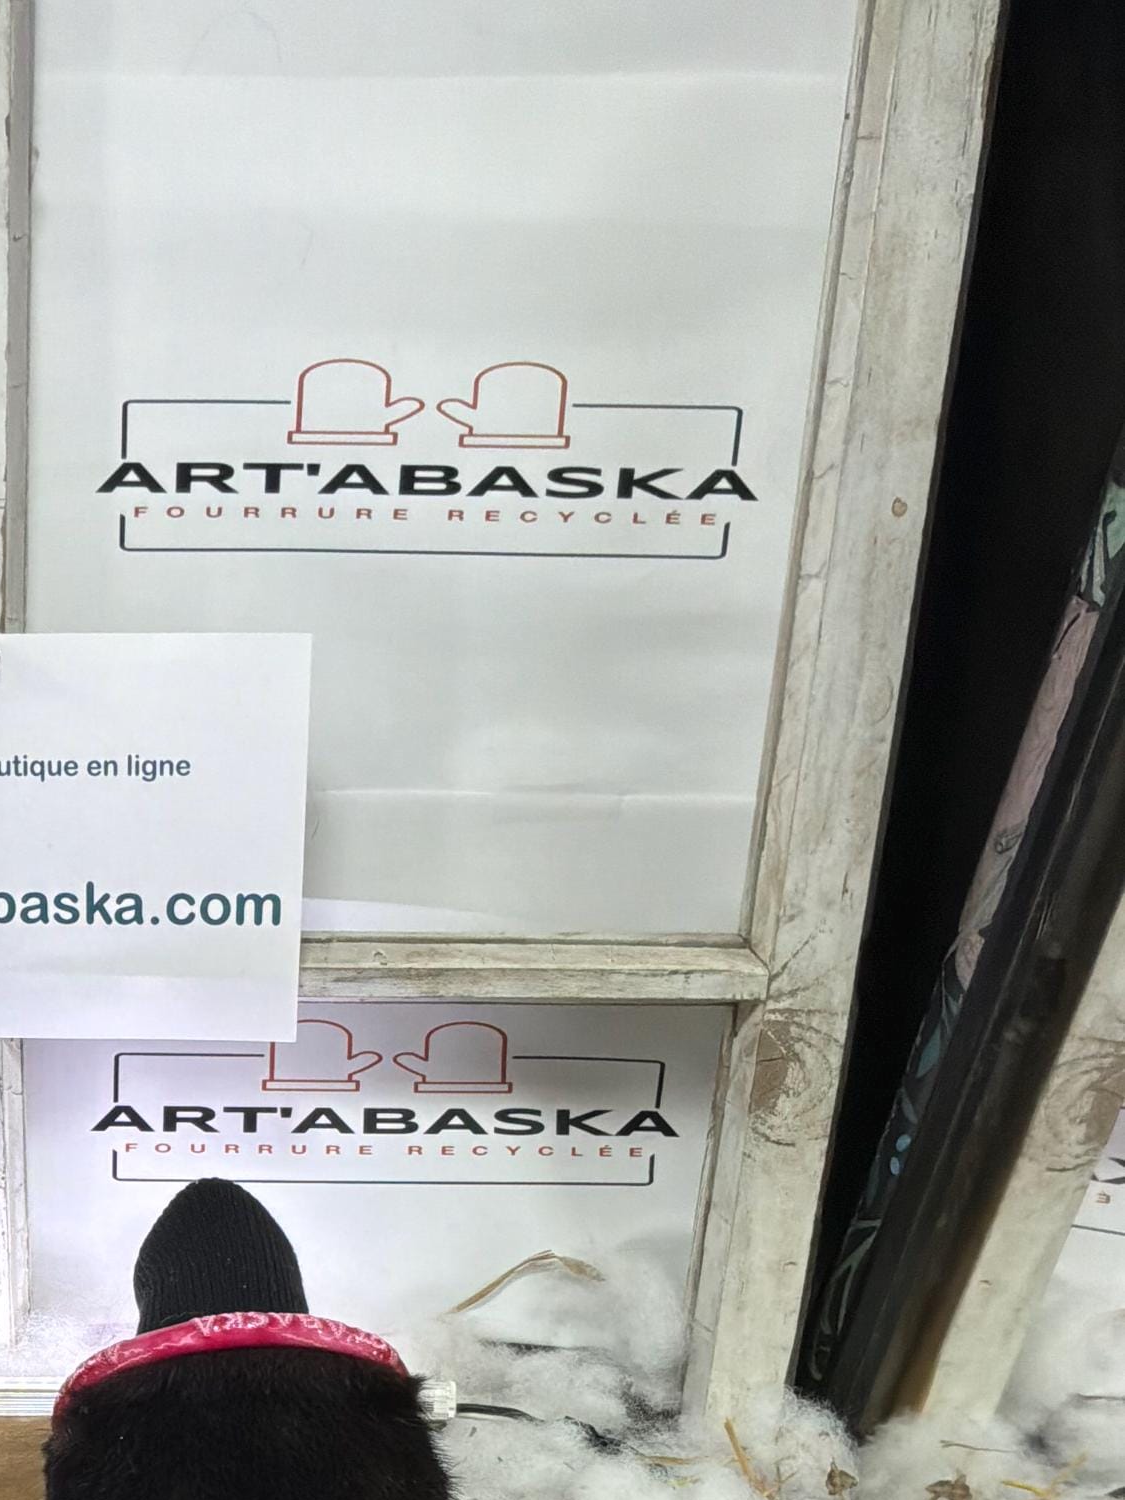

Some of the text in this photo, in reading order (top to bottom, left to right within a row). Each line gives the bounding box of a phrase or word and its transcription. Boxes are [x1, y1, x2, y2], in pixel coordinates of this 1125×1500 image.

[96, 462, 759, 502] ART'ABASKA
[133, 505, 716, 526] FOURRURE RECYCLÉE
[86, 760, 119, 778] en
[126, 754, 192, 782] ligne
[91, 1105, 680, 1138] ART'ABASKA
[124, 1142, 644, 1158] FOURRURE RECYCLÉE
